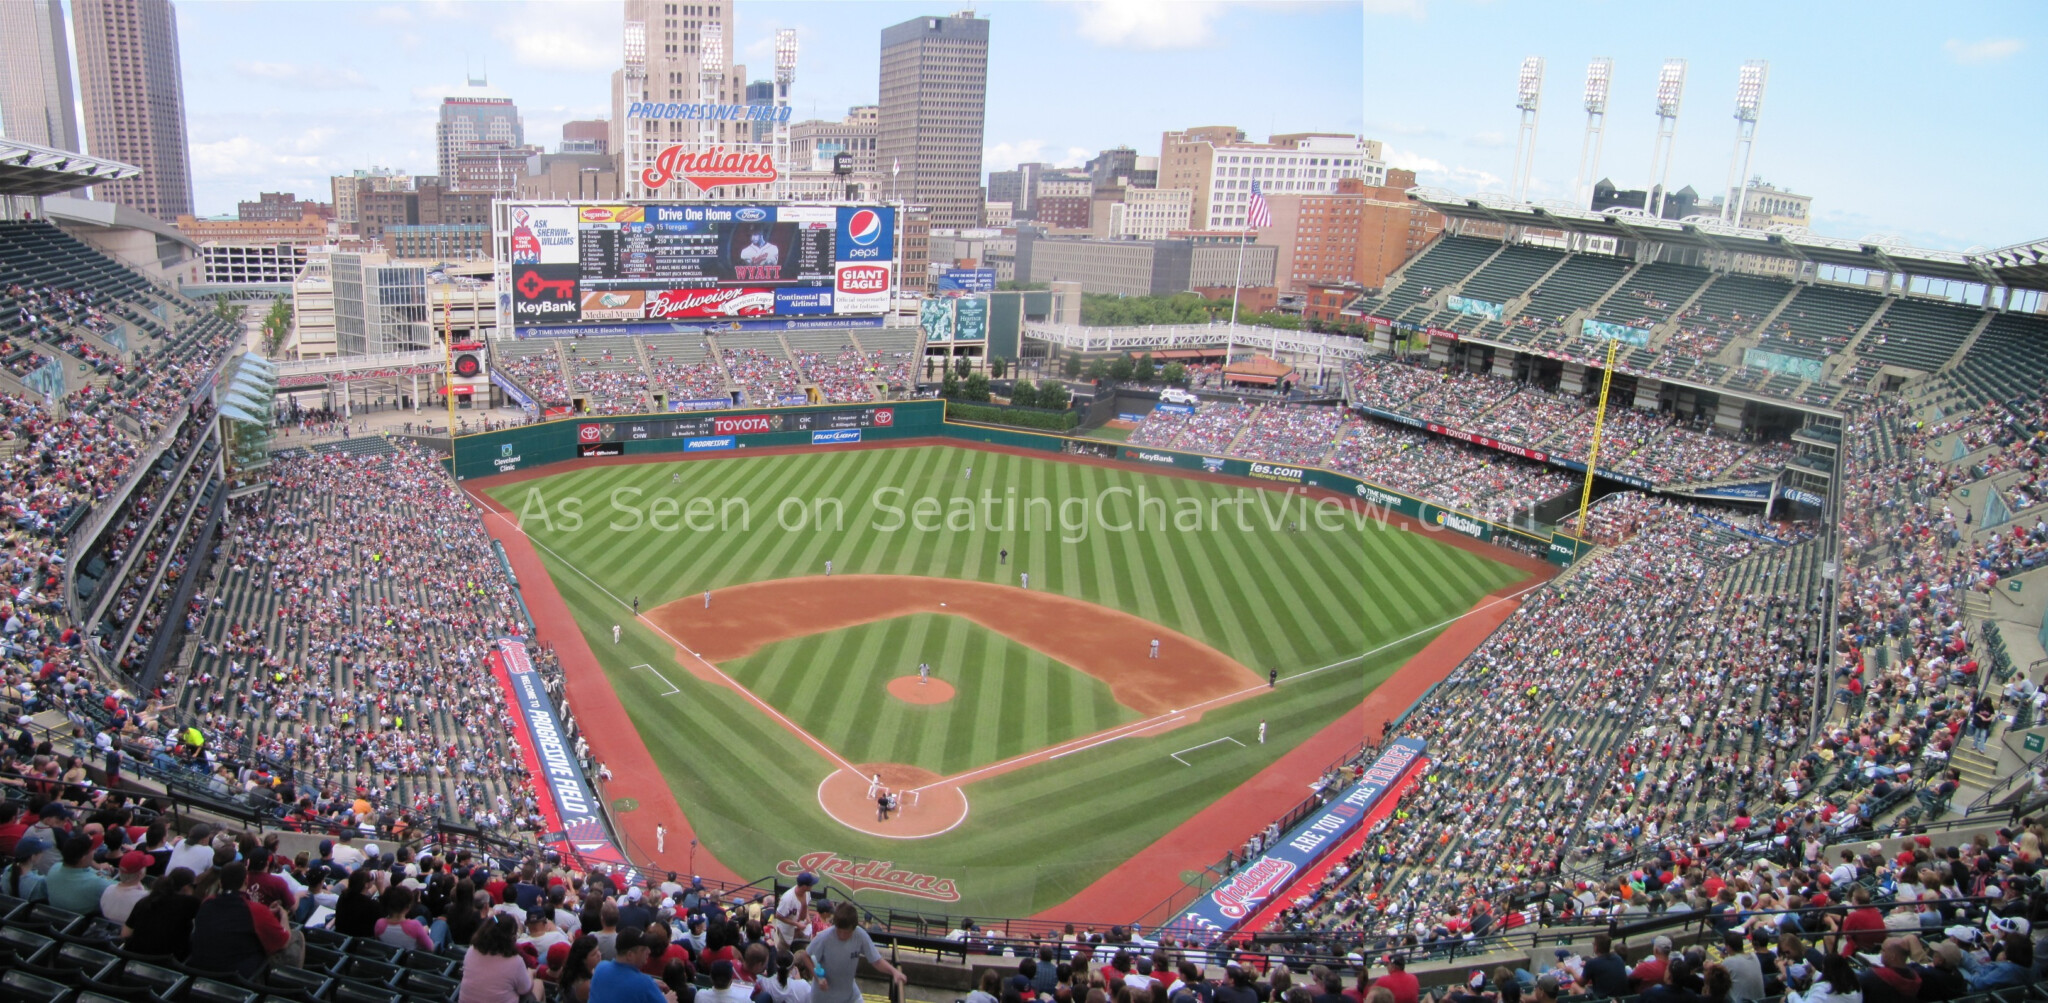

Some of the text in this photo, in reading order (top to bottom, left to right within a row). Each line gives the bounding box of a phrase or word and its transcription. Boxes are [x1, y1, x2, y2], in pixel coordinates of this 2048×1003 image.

[628, 102, 792, 122] PROGRESSIVE FIELD
[642, 144, 778, 193] Indians
[582, 210, 613, 219] Sugardale
[658, 208, 732, 221] Drive One Home
[741, 210, 762, 219] Ford
[534, 220, 548, 228] ASK
[537, 229, 570, 237] SHERWIN-
[542, 237, 574, 245] WILLIAMS
[850, 247, 879, 258] pepsi
[735, 266, 782, 279] WYATT
[842, 270, 884, 280] GIANT
[843, 280, 882, 289] EAGLE
[518, 301, 576, 315] KeyBank
[646, 288, 743, 318] Budweiser
[728, 296, 772, 310] American Lager
[586, 310, 640, 319] Medical Mutual
[1371, 317, 1388, 325] TOYOTA
[1437, 331, 1454, 339] TOYOTA
[716, 419, 769, 431] TOYOTA
[1445, 428, 1472, 441] TOYOTA
[688, 440, 731, 448] PROGRESSIVE
[1497, 442, 1526, 456] TOYOTA
[494, 455, 521, 466] Cleveland
[1139, 452, 1174, 463] KeyBank
[500, 464, 515, 472] Clinic
[1250, 462, 1303, 478] fes.com
[1366, 494, 1381, 504] CABLE
[1367, 488, 1401, 504] TIME WARNER
[1447, 514, 1482, 537] InkStop
[498, 638, 535, 674] Indians
[520, 675, 537, 700] WELCOME
[528, 709, 574, 776] PROGRESSIVE
[553, 777, 588, 813] FIELD
[1290, 744, 1418, 853] ARE YOU IN THE TRIBE?
[776, 852, 961, 902] Indians
[1211, 855, 1296, 919] Indians
